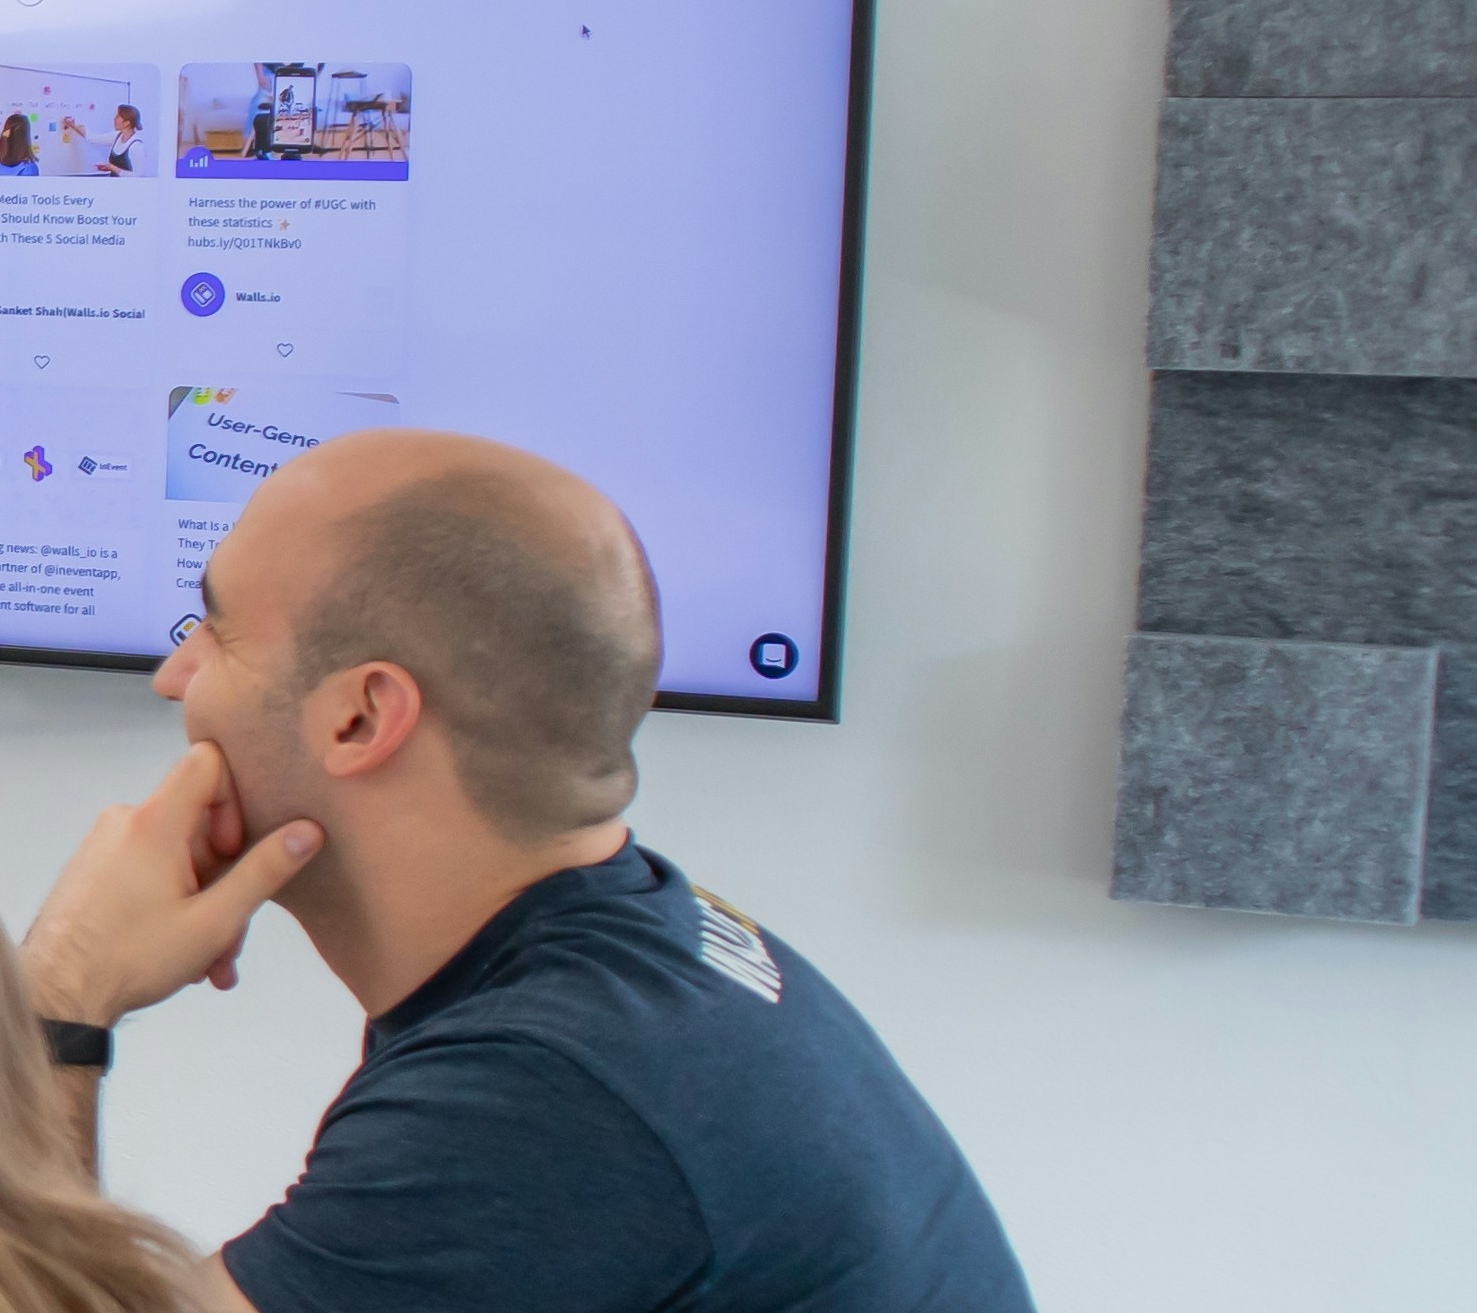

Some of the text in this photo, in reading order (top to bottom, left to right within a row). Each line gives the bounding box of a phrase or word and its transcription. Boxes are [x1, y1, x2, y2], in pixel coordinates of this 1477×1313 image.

[31, 194, 61, 206] Tools
[63, 194, 95, 209] Every
[188, 196, 376, 212] Harness the power of #UGC with
[0, 212, 40, 225] Should
[42, 213, 75, 225] Know
[76, 213, 109, 226] Boost
[111, 214, 138, 226] Your
[188, 216, 274, 230] these statistics
[11, 232, 44, 245] These
[55, 233, 89, 246] Social
[91, 234, 125, 246] Media
[235, 291, 281, 303] Walls.io
[112, 307, 146, 320] Social
[177, 518, 208, 532] What
[177, 537, 206, 552] They
[40, 544, 97, 560] @walls_io
[176, 557, 203, 569] How
[30, 562, 44, 574] of
[43, 563, 121, 581] @ineventapp,
[8, 581, 61, 596] all-in-one
[62, 586, 95, 598] event
[13, 600, 62, 615] software
[63, 603, 79, 616] for
[81, 603, 96, 617] all
